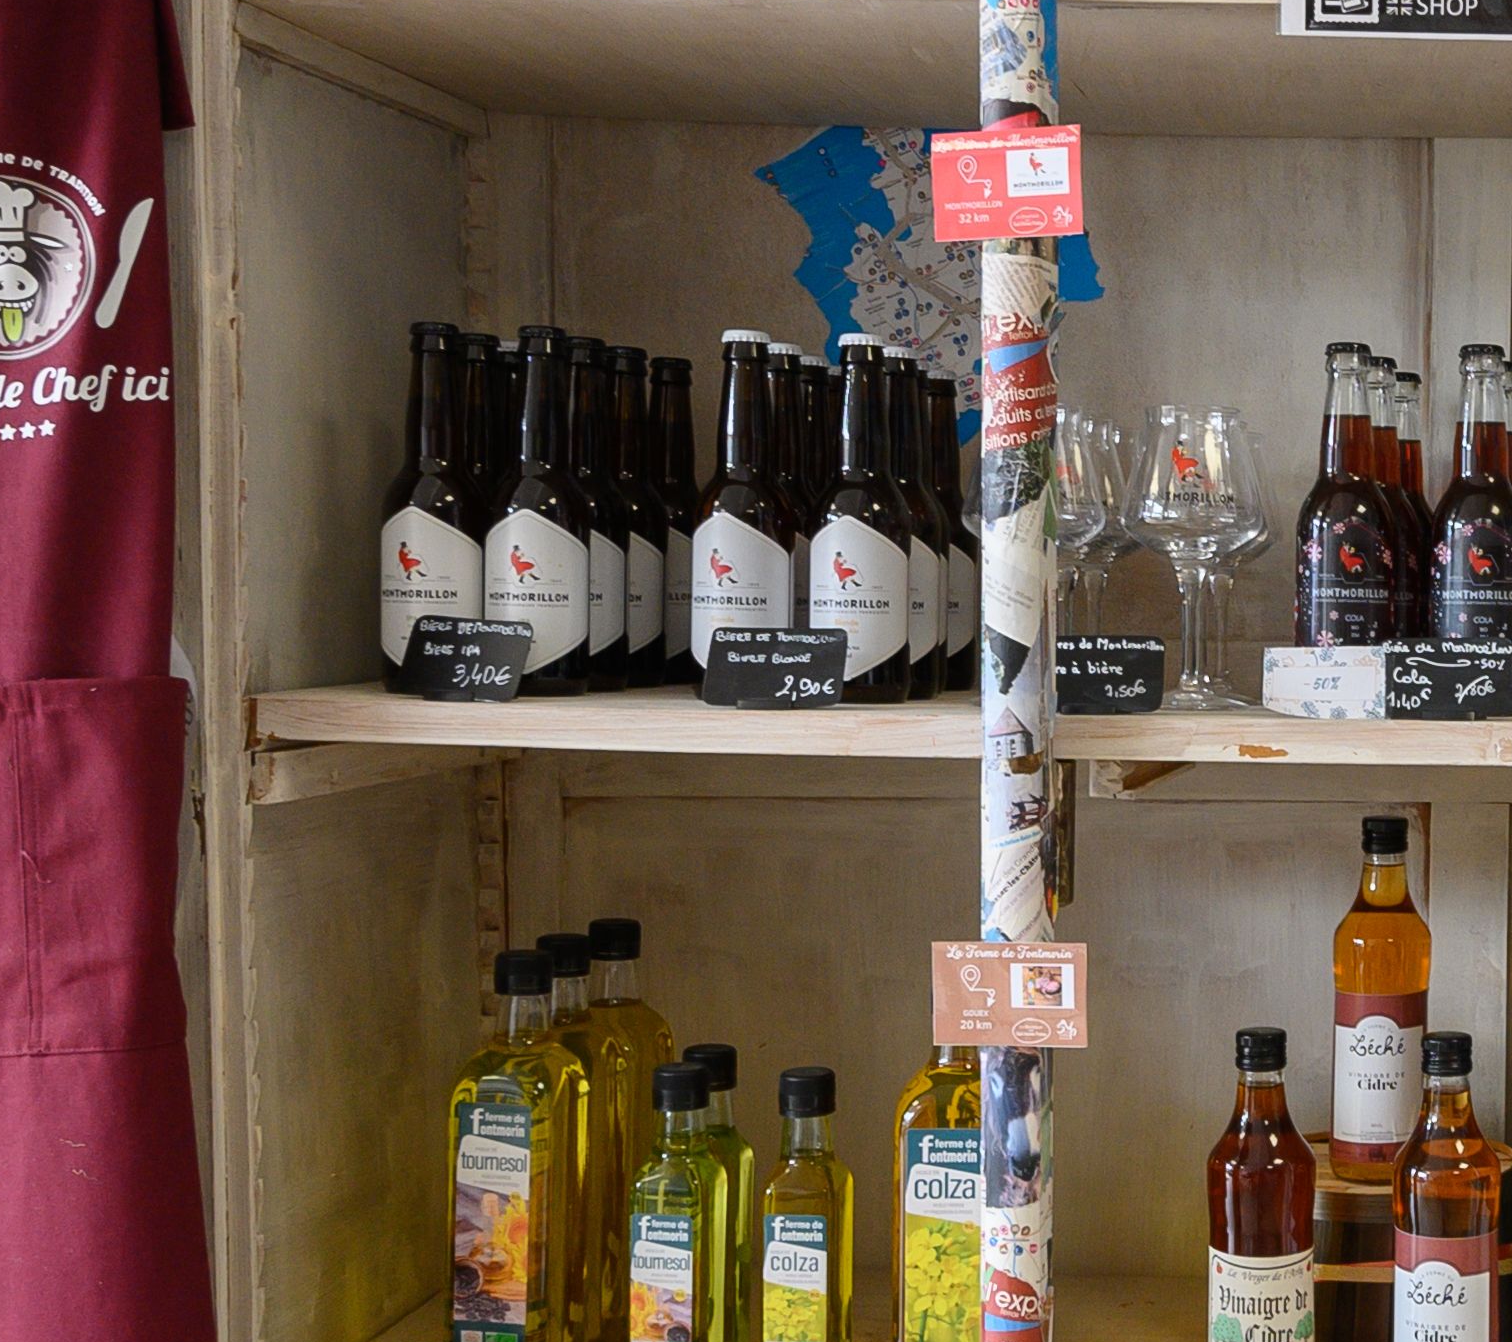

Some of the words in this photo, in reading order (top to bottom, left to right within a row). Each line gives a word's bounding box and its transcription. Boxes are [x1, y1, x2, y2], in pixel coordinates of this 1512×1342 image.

[22, 156, 42, 170] DE
[49, 165, 106, 217] TRADITION
[959, 213, 971, 224] 32
[974, 212, 990, 222] km
[32, 364, 117, 413] Chef
[121, 366, 170, 402] ici
[489, 591, 569, 603] MONTMORILLON
[1312, 588, 1388, 600] MONTMORILLON
[453, 664, 513, 687] 3,40€
[1393, 667, 1433, 685] Cola
[775, 675, 835, 697] 2,90€
[947, 945, 964, 959] La
[965, 945, 1000, 958] Ferme
[1002, 946, 1015, 958] de
[1017, 945, 1074, 959] Fontmorin
[960, 1020, 974, 1030] 20
[976, 1020, 992, 1030] km
[1348, 1033, 1407, 1058] Léché
[1357, 1077, 1398, 1092] Cidre
[485, 1113, 511, 1124] ferme
[514, 1114, 525, 1123] de
[934, 1138, 963, 1149] ferme
[965, 1138, 978, 1149] de
[461, 1152, 528, 1173] tournesol
[914, 1173, 976, 1200] colza
[632, 1254, 691, 1271] tournesol
[770, 1252, 819, 1272] colza
[1407, 1279, 1469, 1307] Léché
[1218, 1285, 1292, 1323] Vinaigre
[1294, 1286, 1309, 1312] de
